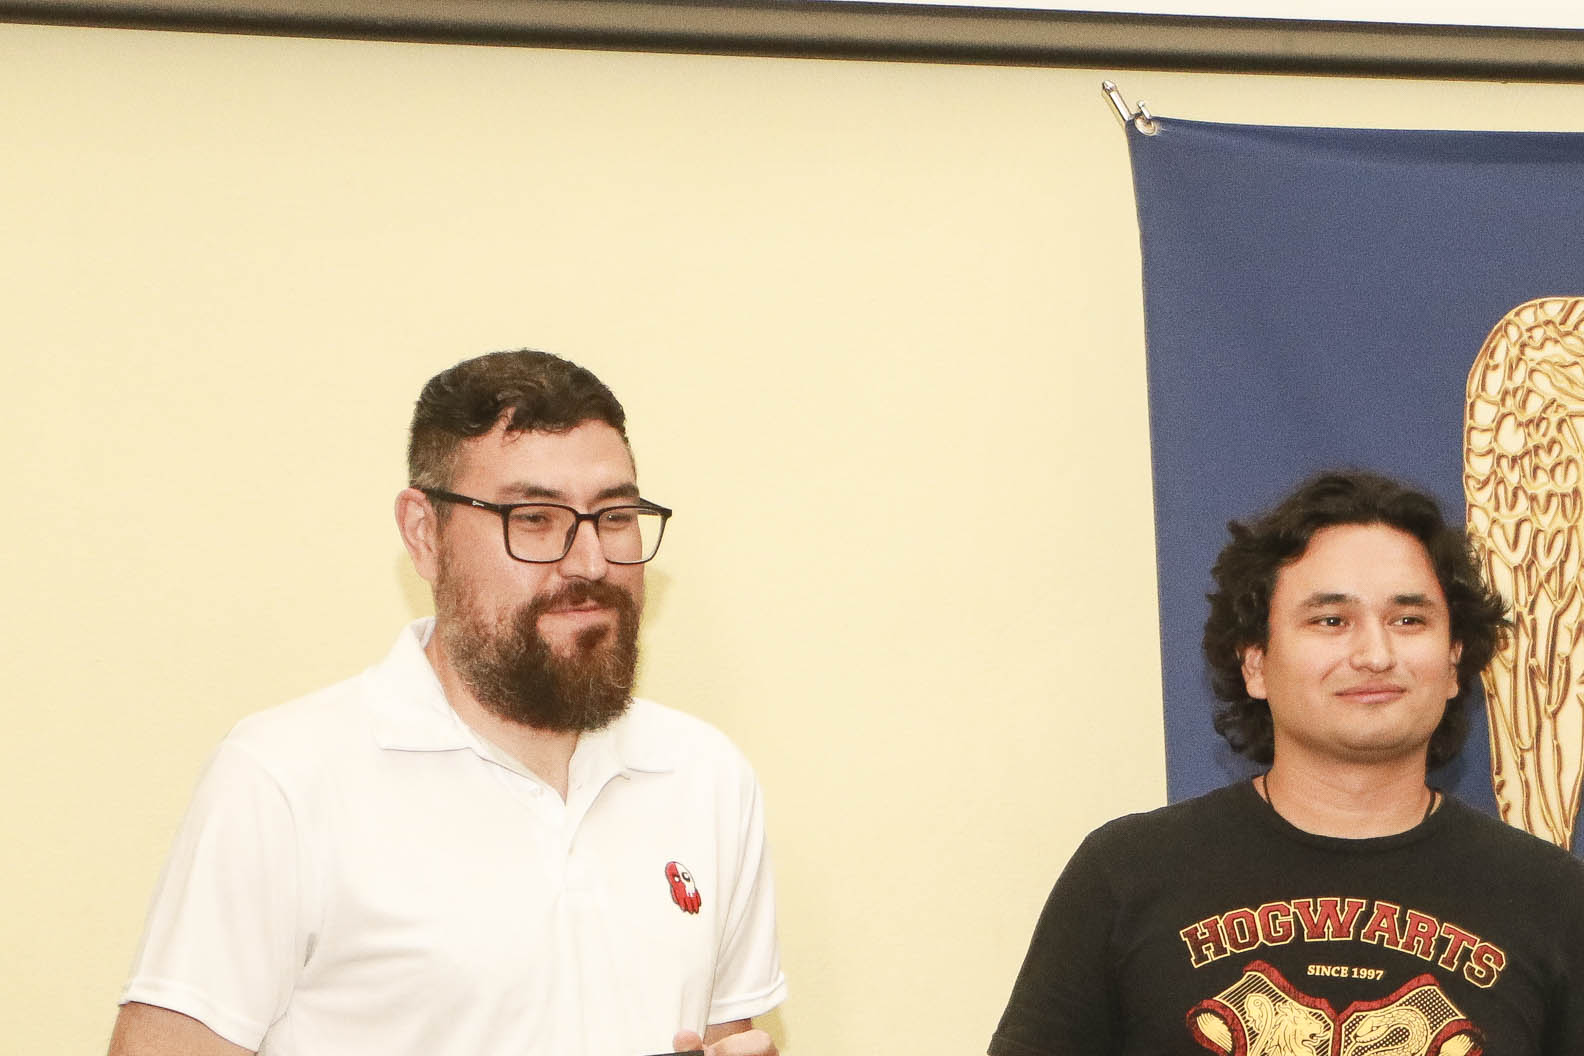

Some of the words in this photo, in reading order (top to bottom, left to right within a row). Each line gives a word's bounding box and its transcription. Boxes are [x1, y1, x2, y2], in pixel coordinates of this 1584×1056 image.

[1180, 897, 1506, 988] HOGWARTS
[1307, 965, 1348, 978] SINCE
[1351, 967, 1384, 981] 1997
